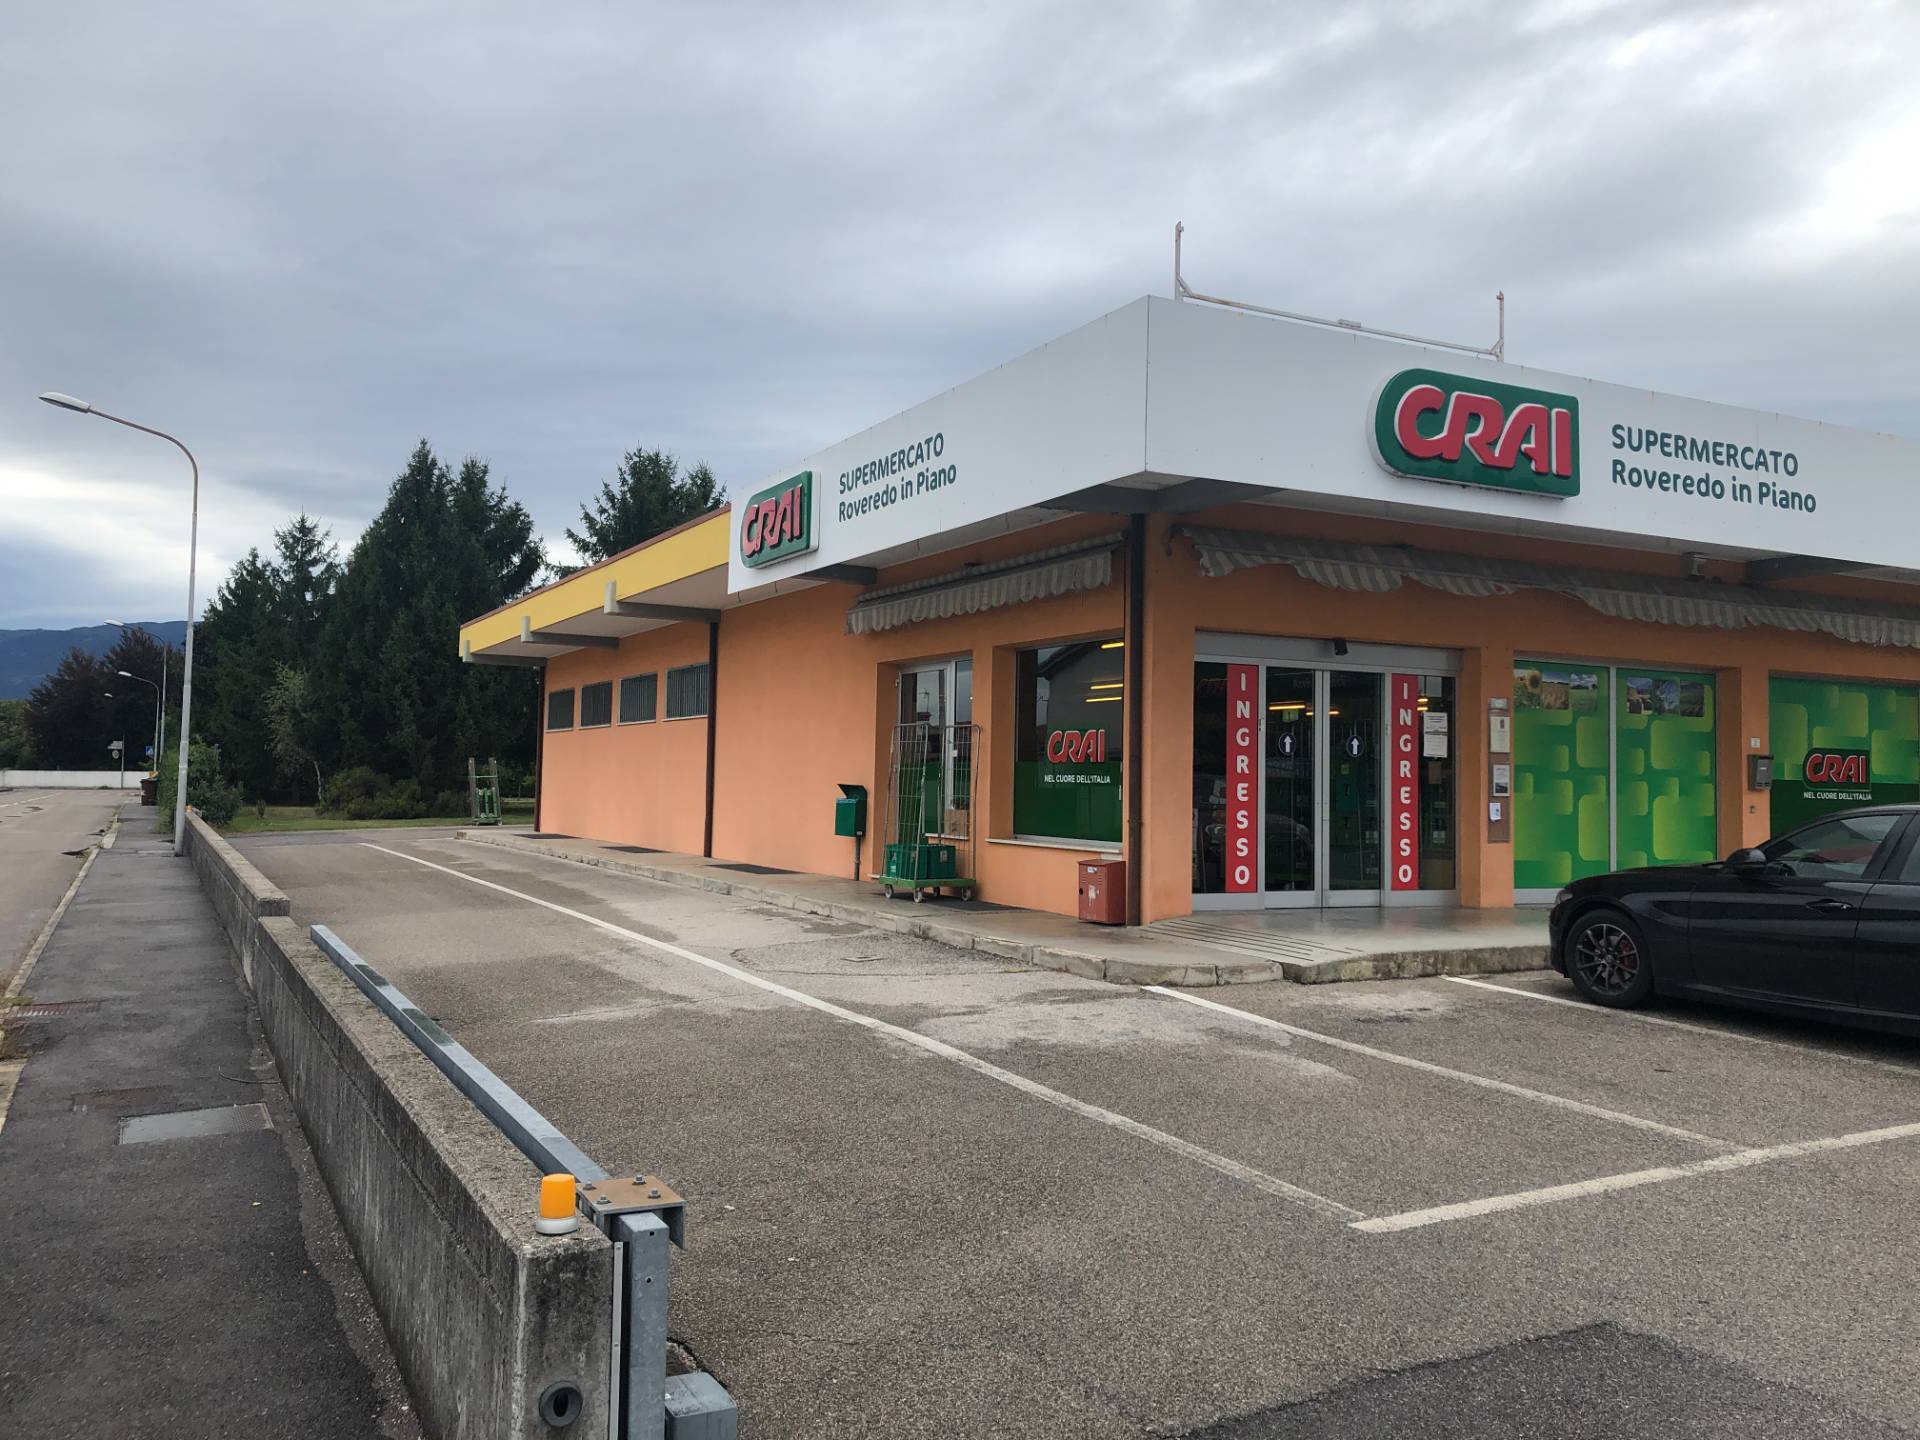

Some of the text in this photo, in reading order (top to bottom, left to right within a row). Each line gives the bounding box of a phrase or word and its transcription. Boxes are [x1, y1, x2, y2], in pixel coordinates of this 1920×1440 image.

[1394, 384, 1572, 477] CRAI
[1611, 423, 1799, 477] SUPERMERCATO
[839, 432, 944, 495] SUPERMERCATO
[1612, 459, 1817, 513] Roveredo in Piano
[741, 484, 804, 558] CRAI
[838, 463, 957, 523] Roveredo in Piano
[1047, 729, 1105, 763] CRAI
[1806, 753, 1867, 784] CRAI
[1044, 775, 1111, 784] NEL CUORE DELL'ITALIA
[1234, 672, 1250, 885] INGRESSO
[1398, 682, 1413, 883] INGRESSO
[1803, 791, 1872, 801] NEL CUORE DELL'ITALIA
